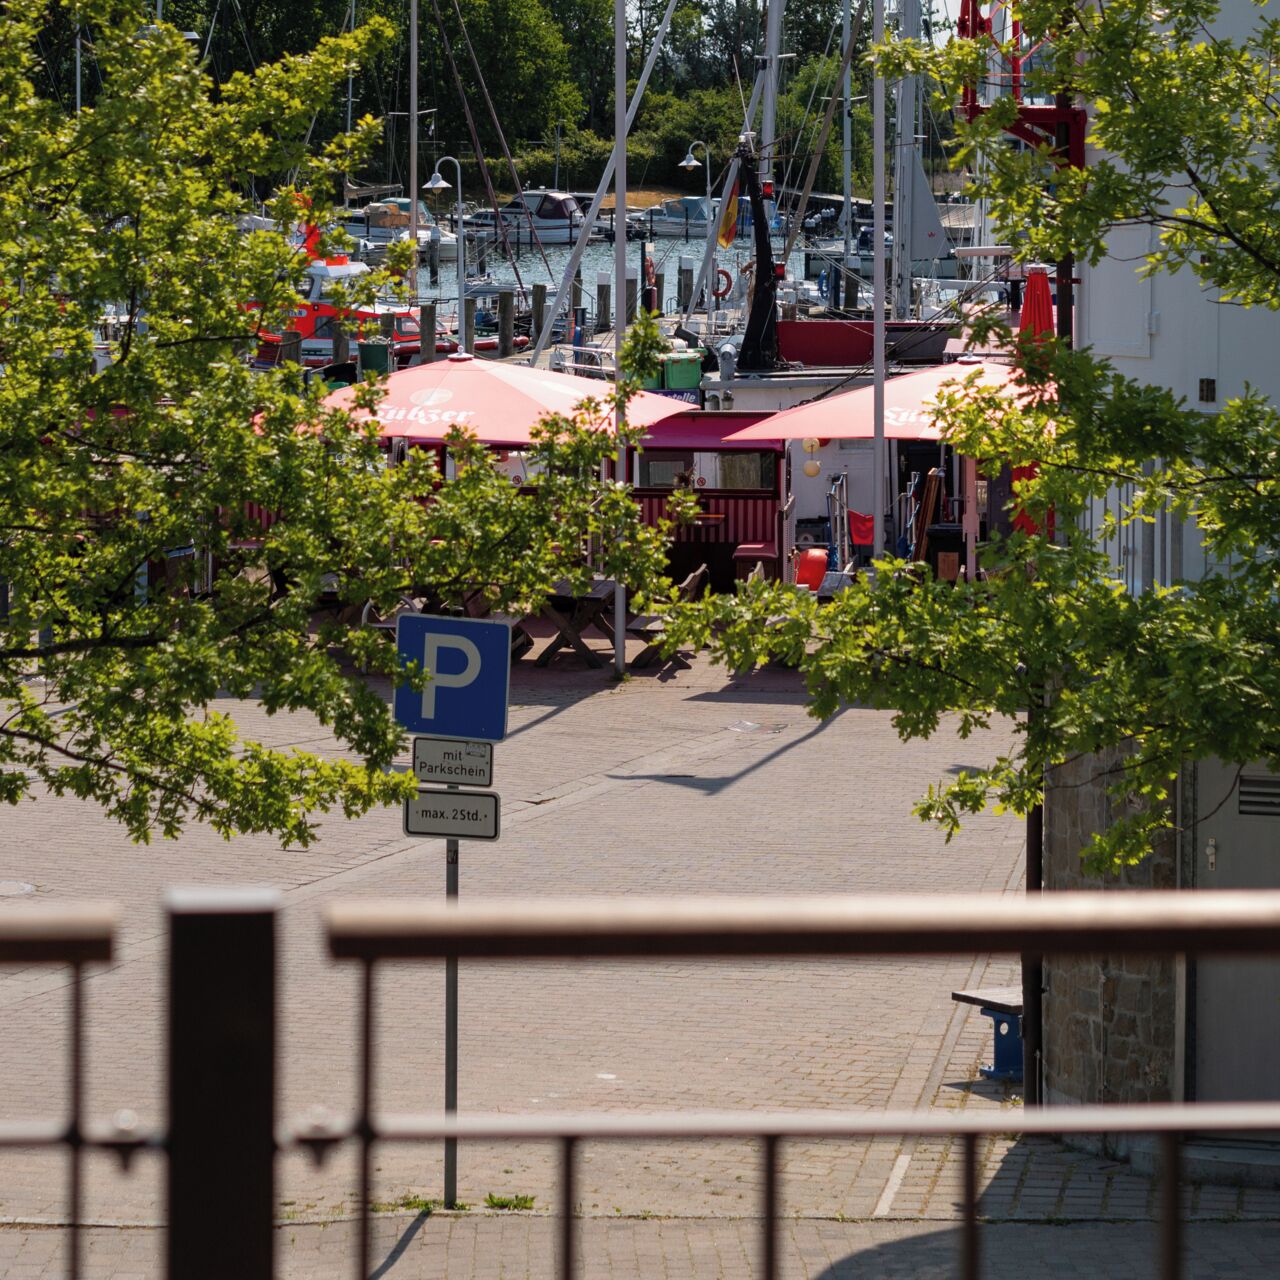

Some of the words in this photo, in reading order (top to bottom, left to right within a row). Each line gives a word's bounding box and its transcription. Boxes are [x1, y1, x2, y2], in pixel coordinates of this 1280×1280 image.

[421, 632, 481, 719] P
[443, 750, 462, 761] mit
[419, 761, 486, 777] Parkschein
[421, 809, 449, 820] max.
